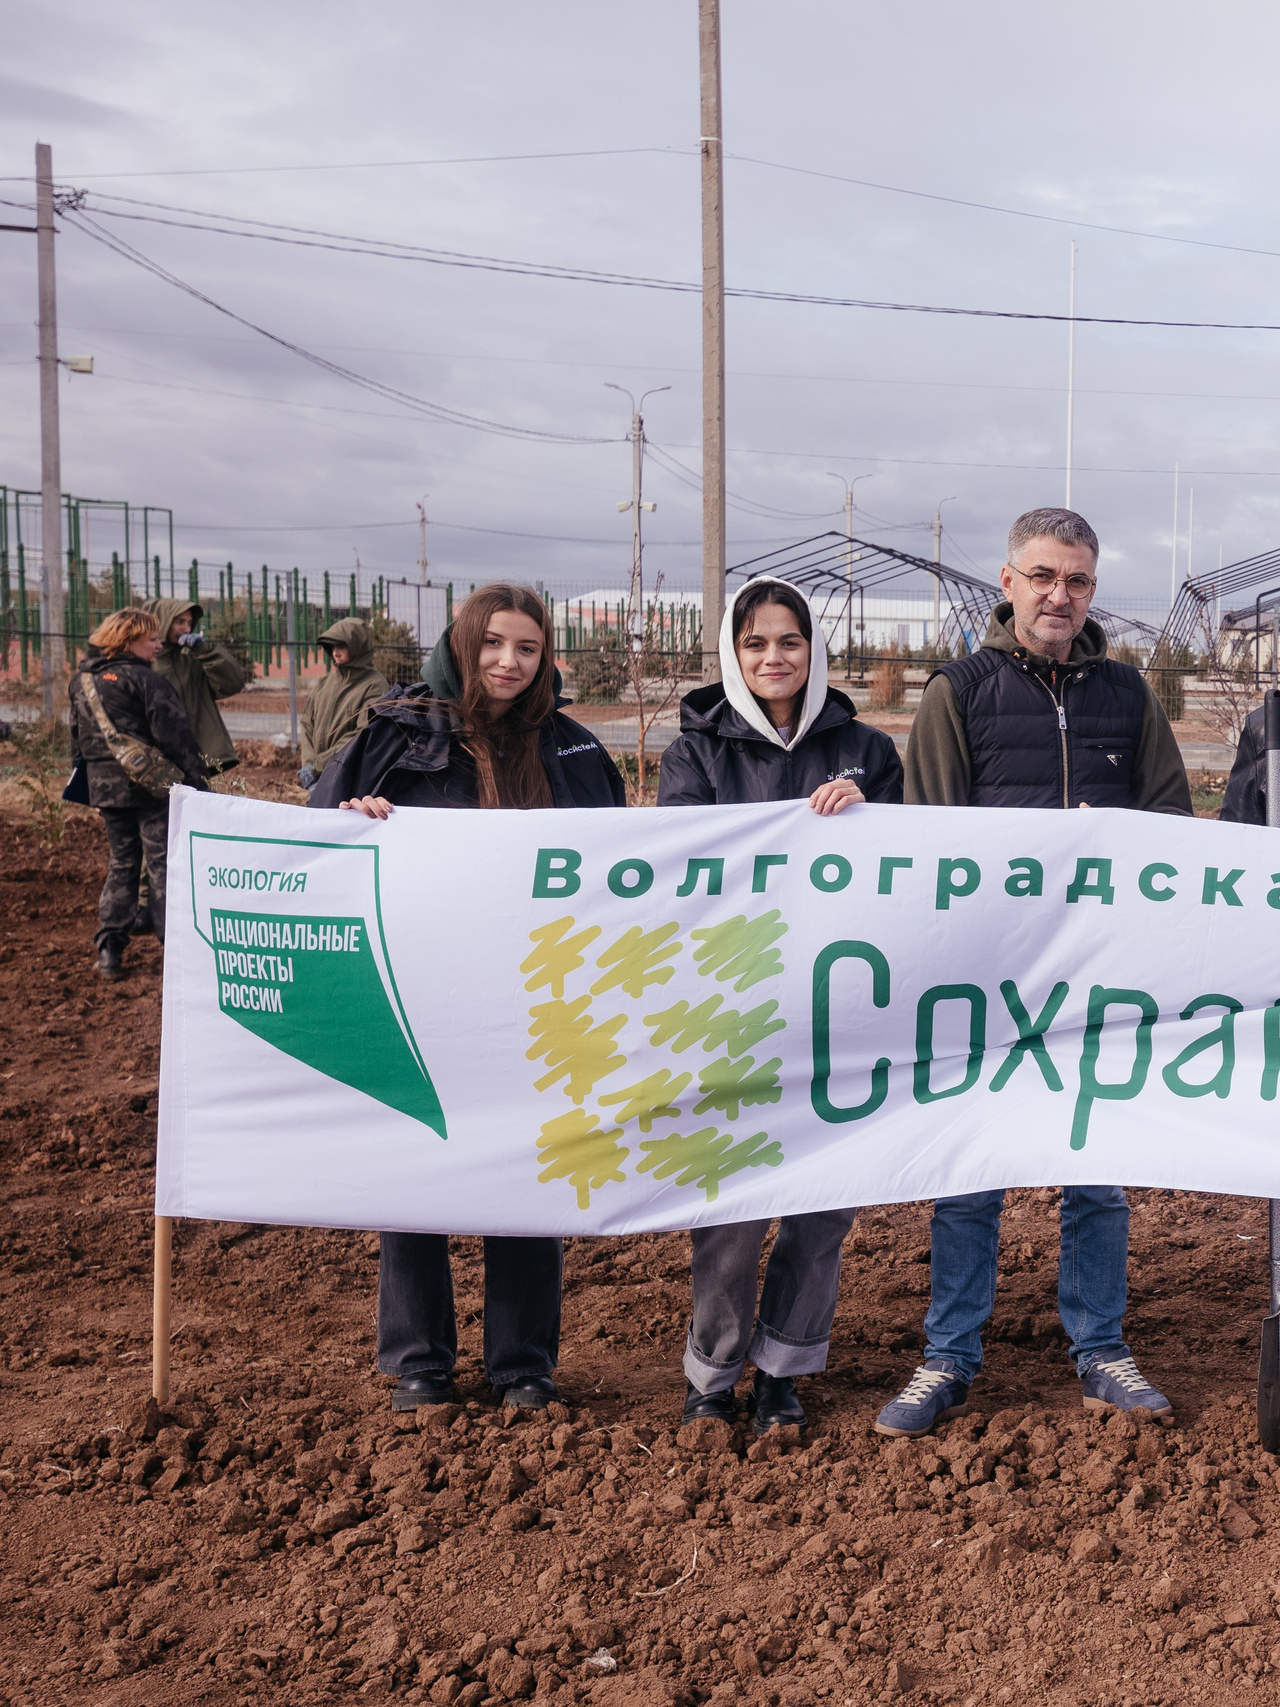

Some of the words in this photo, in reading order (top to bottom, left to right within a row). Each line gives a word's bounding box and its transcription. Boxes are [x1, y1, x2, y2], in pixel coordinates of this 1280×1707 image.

[557, 741, 598, 757] косистем
[208, 866, 307, 892] ЭКОЛОГИЯ
[214, 916, 362, 952] НАЦИОНАЛЬНЫЕ
[217, 949, 294, 982] ПРОЕКТЫ
[221, 981, 283, 1013] РОССИИ
